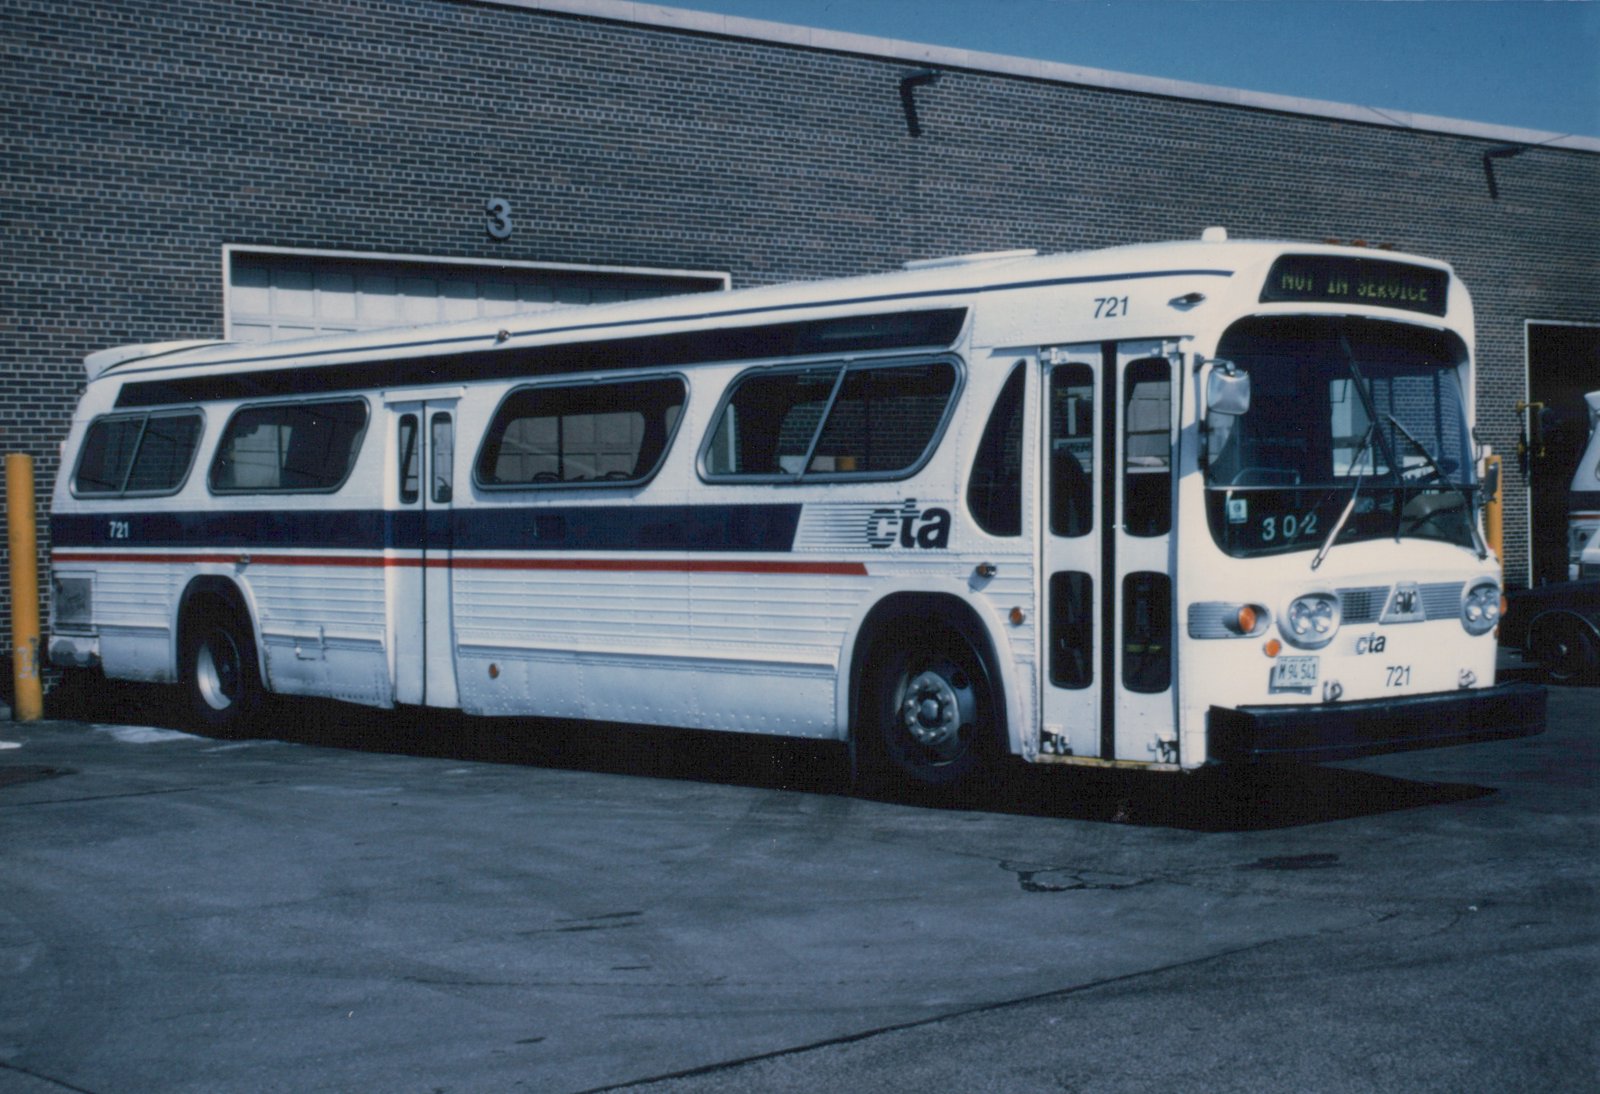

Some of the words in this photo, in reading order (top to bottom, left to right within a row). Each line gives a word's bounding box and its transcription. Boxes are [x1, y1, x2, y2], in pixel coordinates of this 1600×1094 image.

[487, 198, 512, 238] 3
[1094, 296, 1128, 319] 721
[109, 520, 129, 538] 721
[866, 498, 951, 549] cta
[1355, 631, 1386, 655] cta
[1386, 665, 1411, 687] 721
